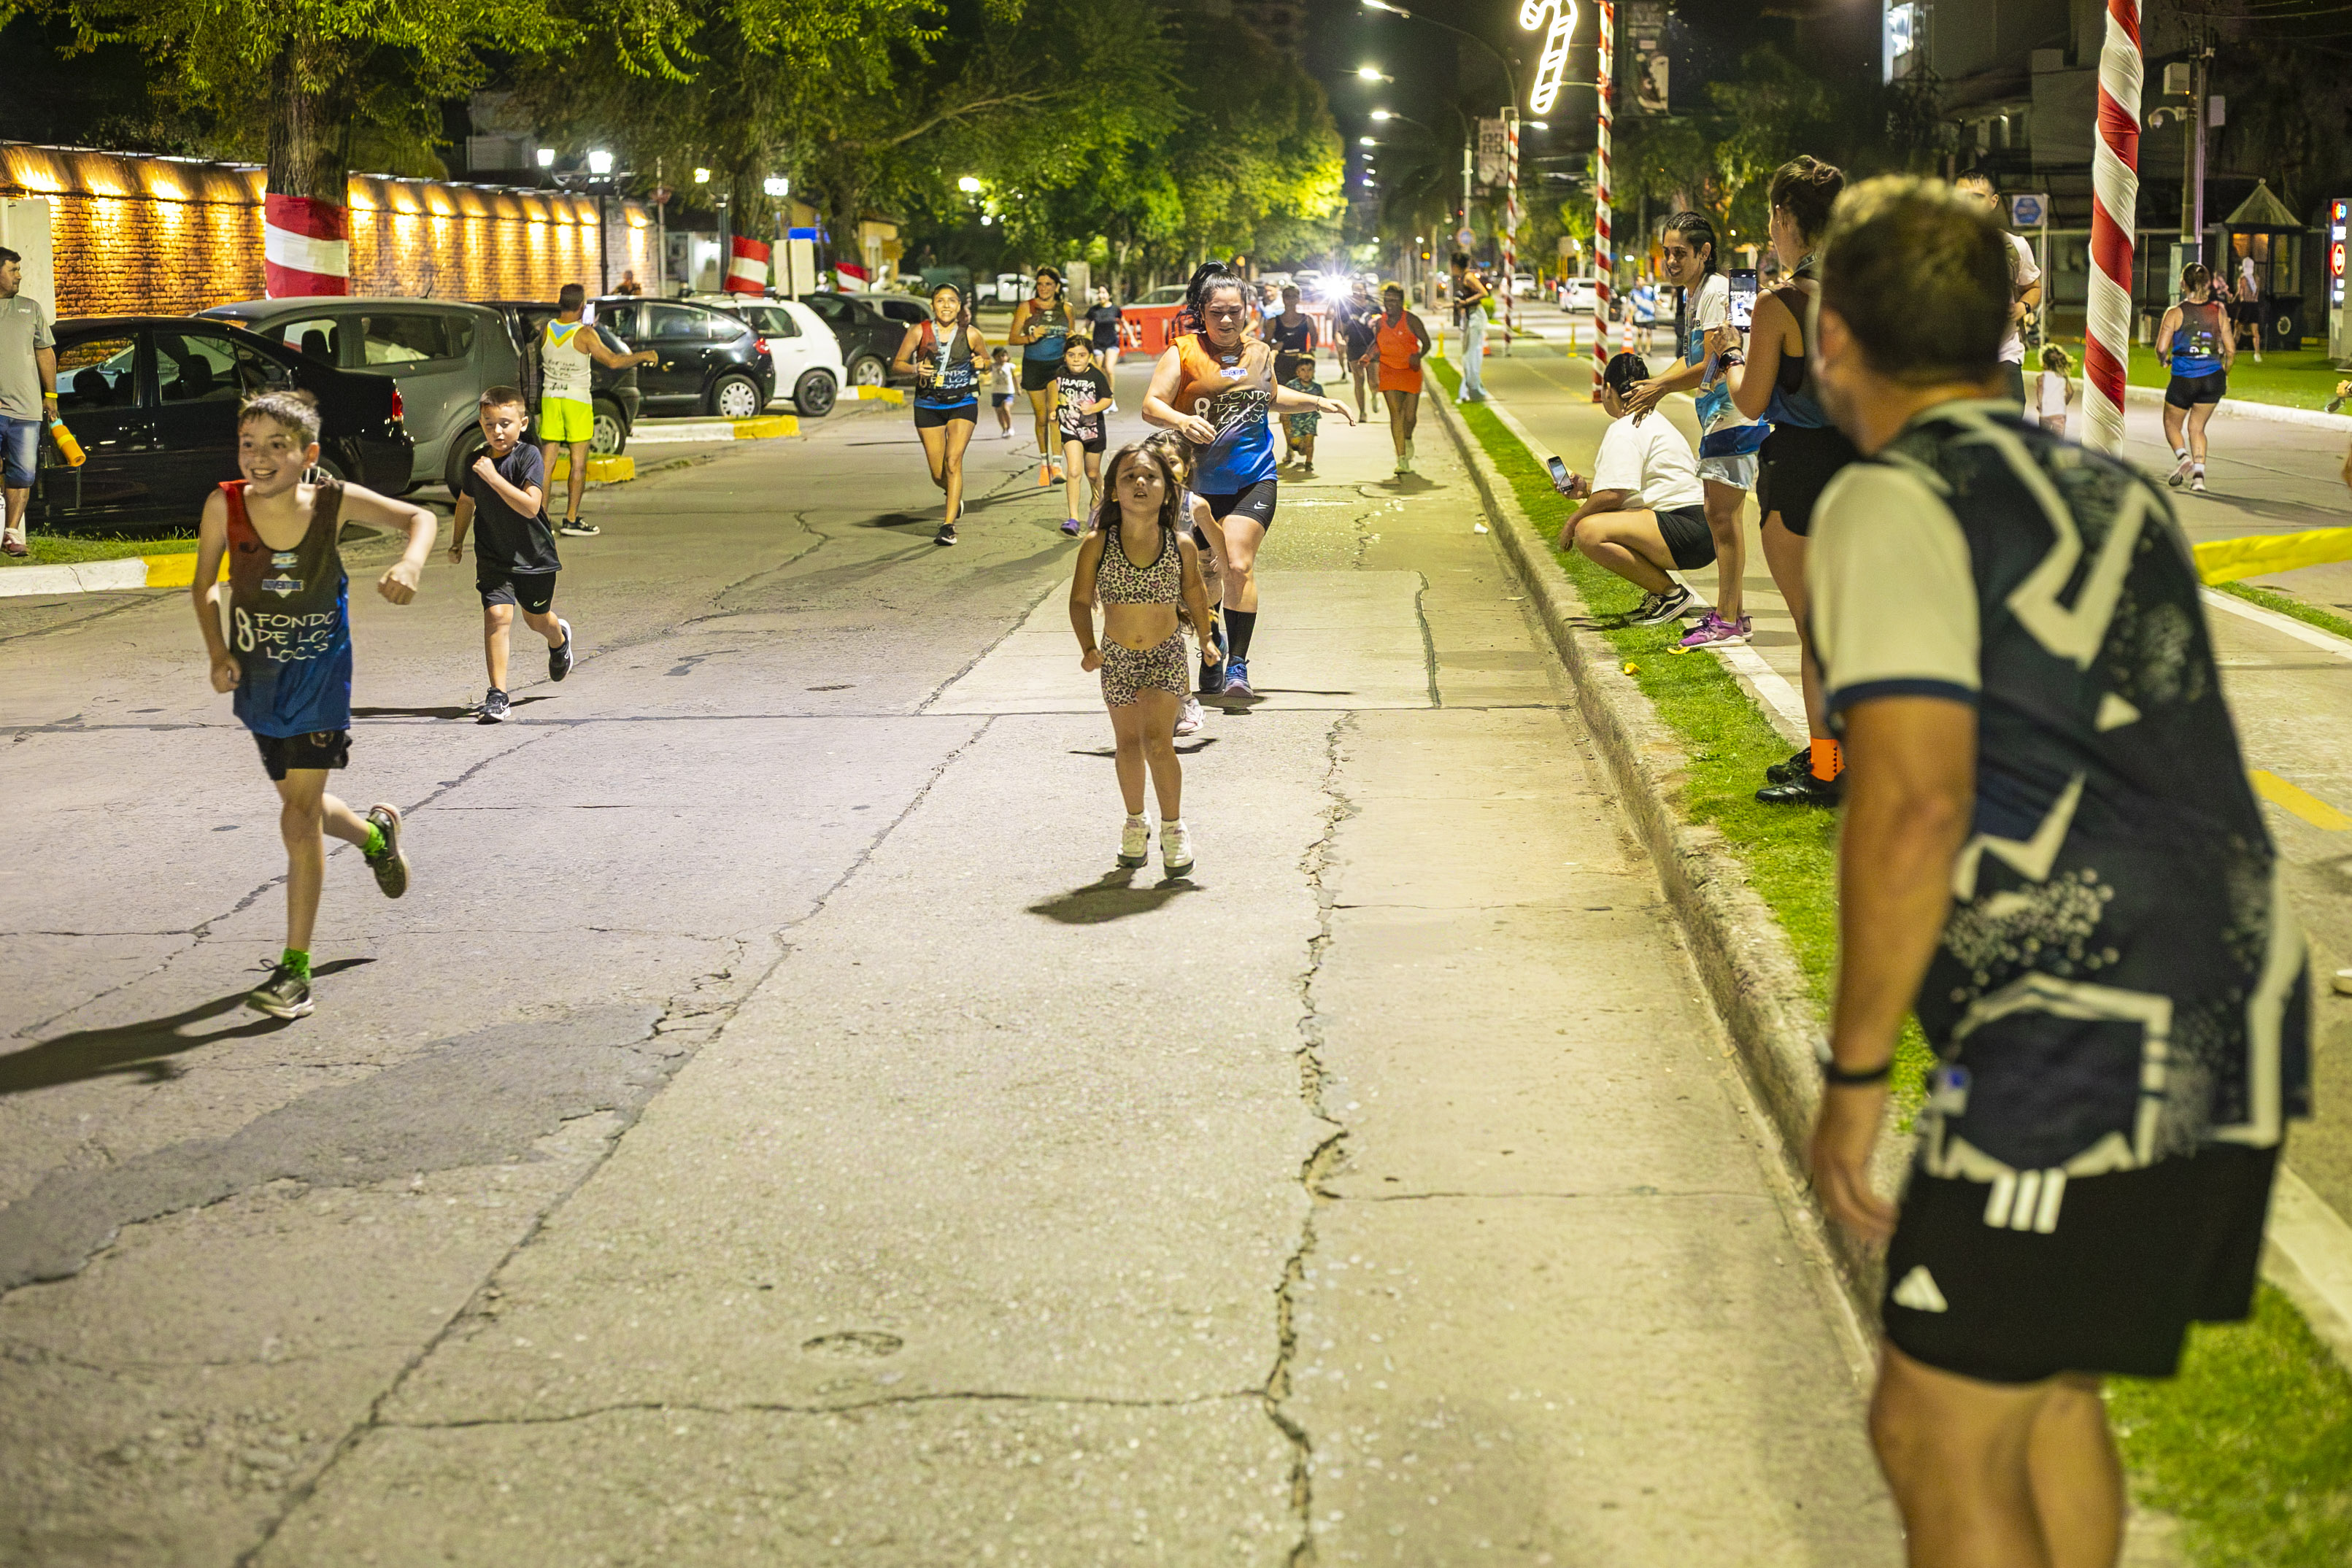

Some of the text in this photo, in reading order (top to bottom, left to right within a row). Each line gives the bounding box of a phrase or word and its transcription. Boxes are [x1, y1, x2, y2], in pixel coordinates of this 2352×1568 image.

[931, 369, 968, 377] FNDO
[1217, 390, 1271, 403] FONDO
[1213, 401, 1241, 414] DE
[234, 606, 255, 652] 8
[253, 627, 334, 645] DE LO
